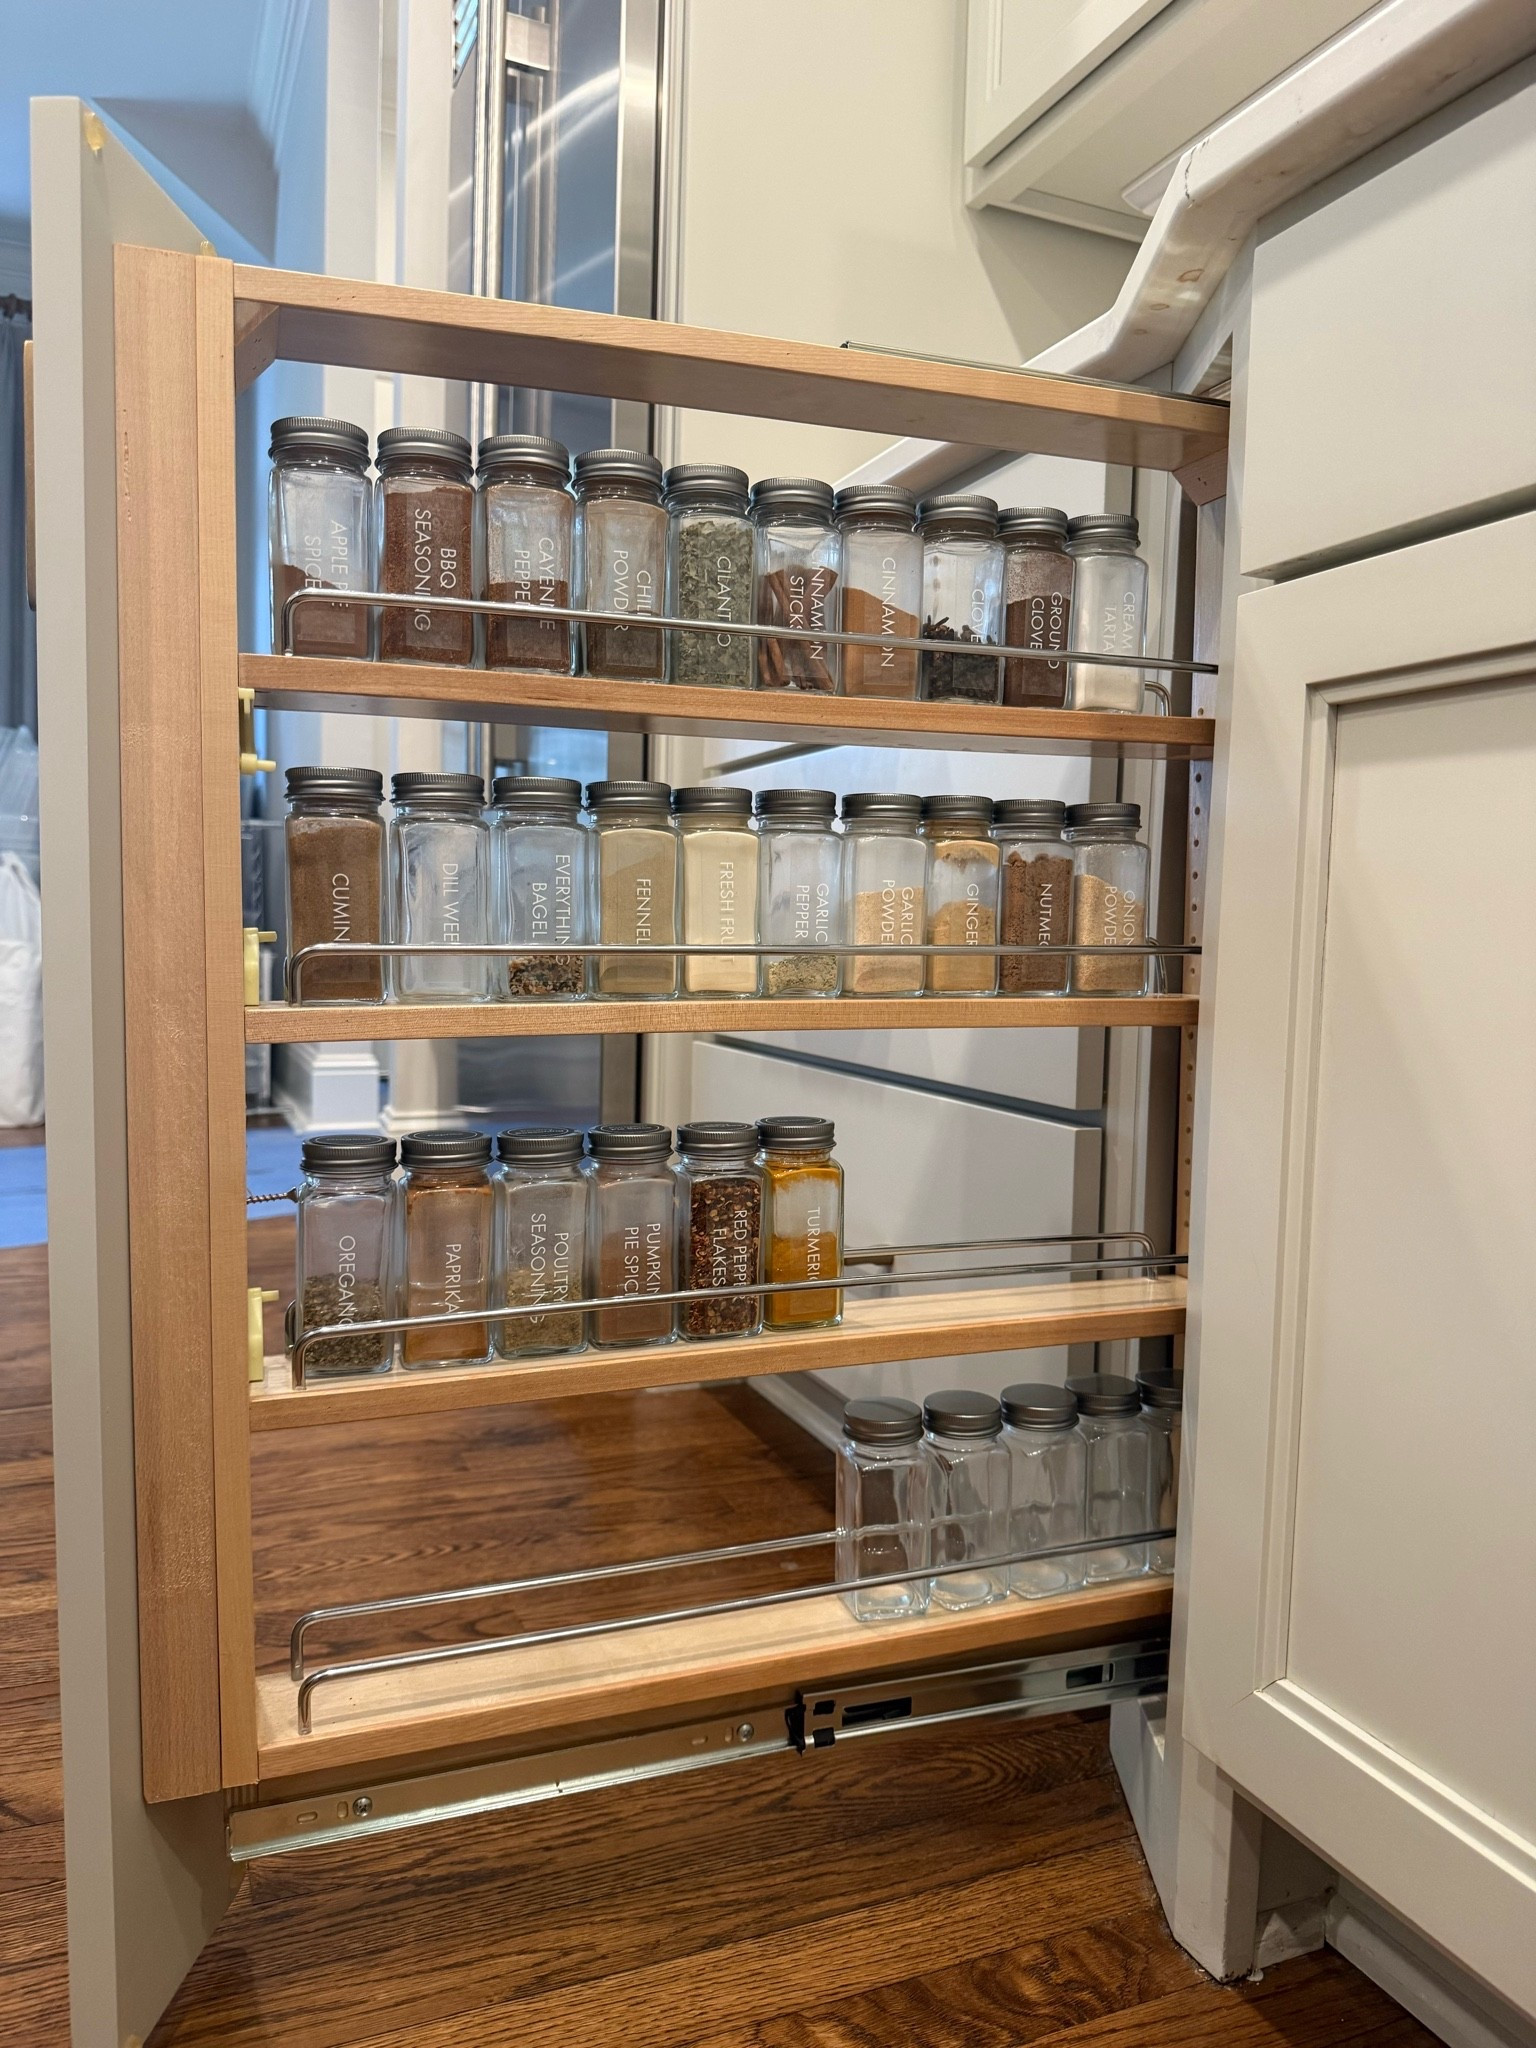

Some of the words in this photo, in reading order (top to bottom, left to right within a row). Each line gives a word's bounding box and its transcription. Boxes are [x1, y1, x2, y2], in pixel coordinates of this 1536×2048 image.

[304, 535, 322, 589] SPICE
[330, 519, 348, 575] APPLE
[414, 508, 431, 632] SEASONIG
[440, 547, 457, 590] BBQ
[514, 549, 531, 606] PEPPE
[613, 550, 629, 632] POWDR
[636, 570, 652, 616] CHILI
[716, 556, 732, 647] CILANTO
[880, 557, 896, 667] CINNAMN
[970, 589, 985, 643] CLOVE
[1029, 597, 1045, 649] CLOVE
[1102, 607, 1117, 652] TARTA
[1122, 591, 1136, 649] CREAM
[332, 873, 350, 942] CUMIN
[442, 863, 459, 897] DILL
[719, 861, 735, 912] FRESH
[443, 901, 460, 943] WEE
[531, 882, 548, 938] BAGEL
[636, 878, 652, 945] FENNEL
[795, 885, 810, 939] PEPPER
[814, 883, 830, 943] GARLIC
[881, 879, 896, 945] POWDE
[900, 886, 915, 945] GARLIC
[1103, 886, 1117, 945] POWDE
[720, 917, 735, 963] FRUT
[624, 1226, 640, 1250] PIE
[733, 1209, 748, 1241] RED
[444, 1243, 462, 1314] PAPRIKA
[553, 1232, 569, 1303] POULTRY
[624, 1255, 640, 1296] SPIC
[712, 1228, 727, 1287] FLAKES
